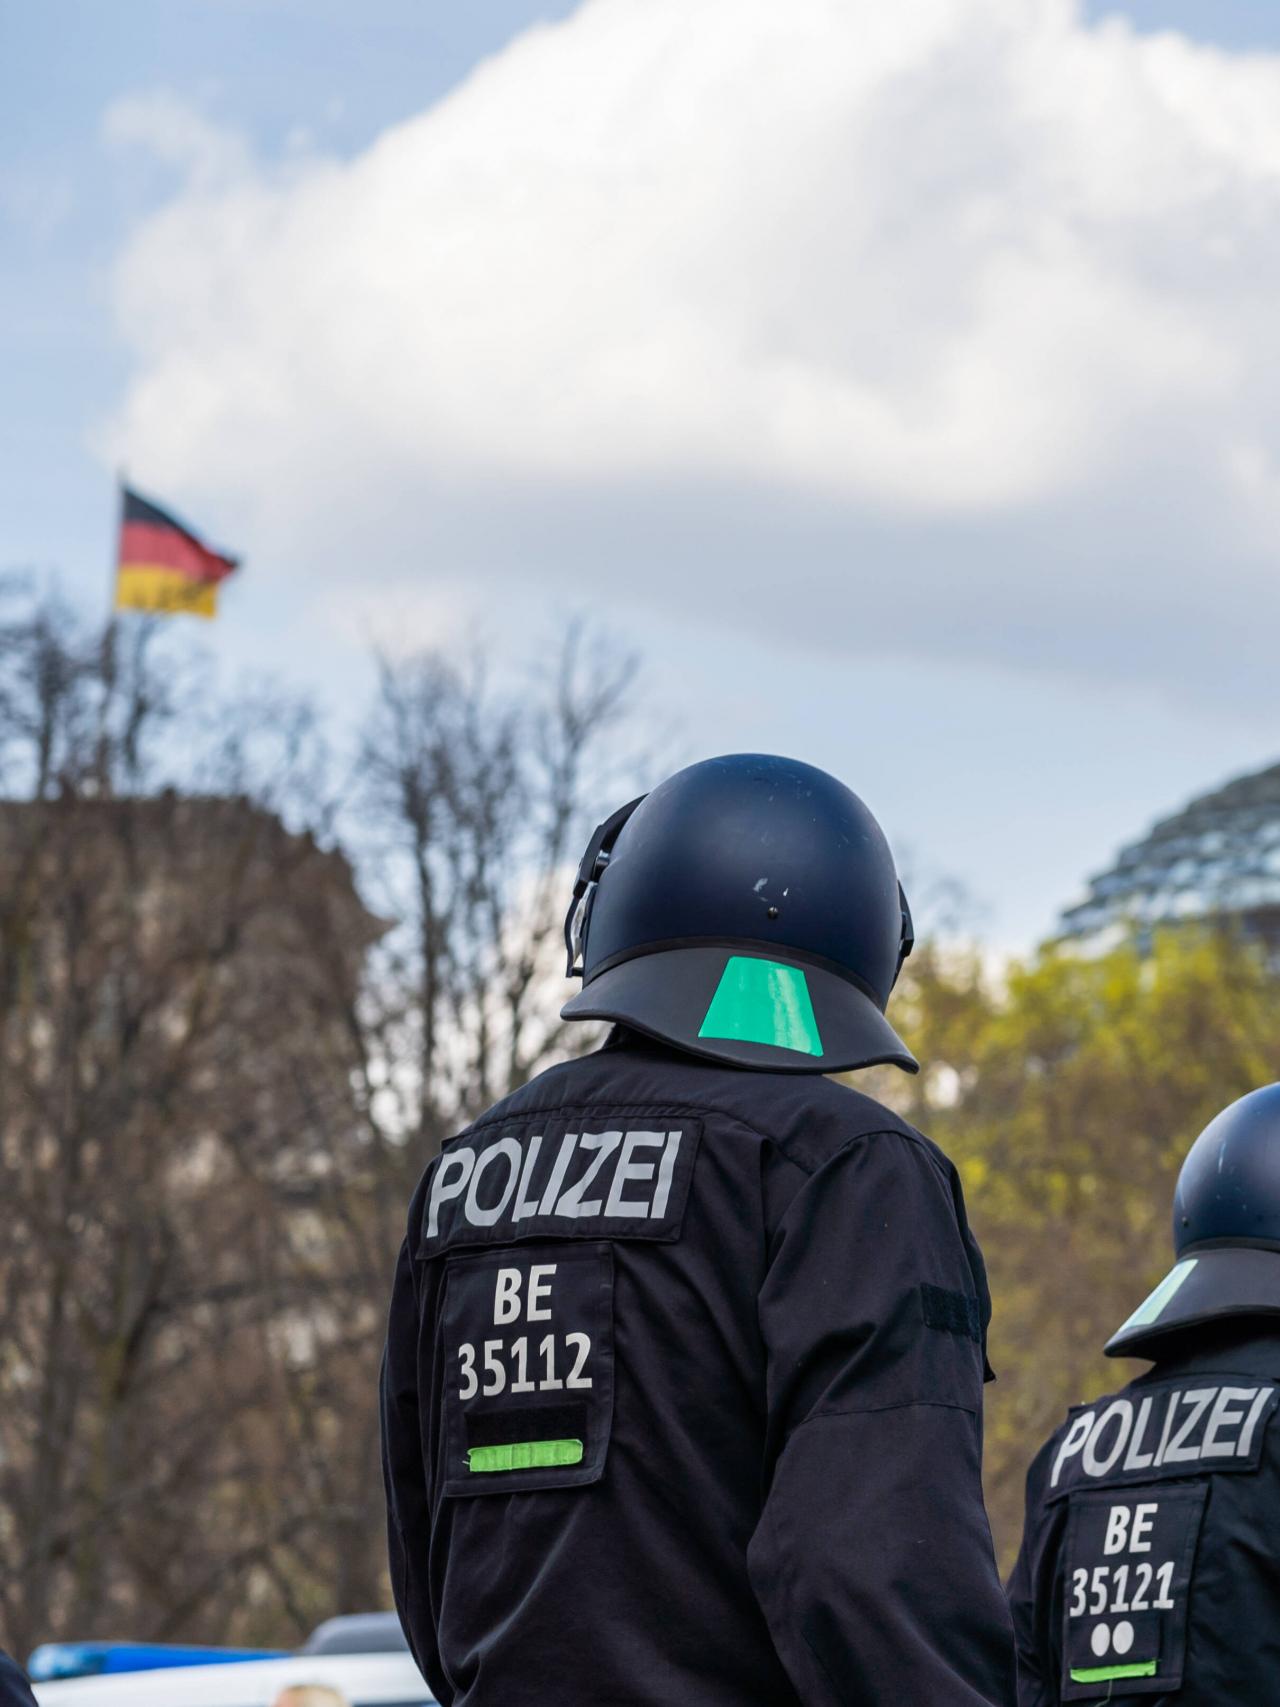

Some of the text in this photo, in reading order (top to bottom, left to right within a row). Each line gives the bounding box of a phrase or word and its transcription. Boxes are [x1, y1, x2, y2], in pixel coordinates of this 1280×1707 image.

[426, 1130, 682, 1238] POLIZEI
[493, 1264, 557, 1325] BE
[458, 1332, 593, 1400] 35112
[1050, 1387, 1275, 1488] POLIZEI
[1103, 1503, 1158, 1555] BE
[1069, 1561, 1175, 1617] 35121
